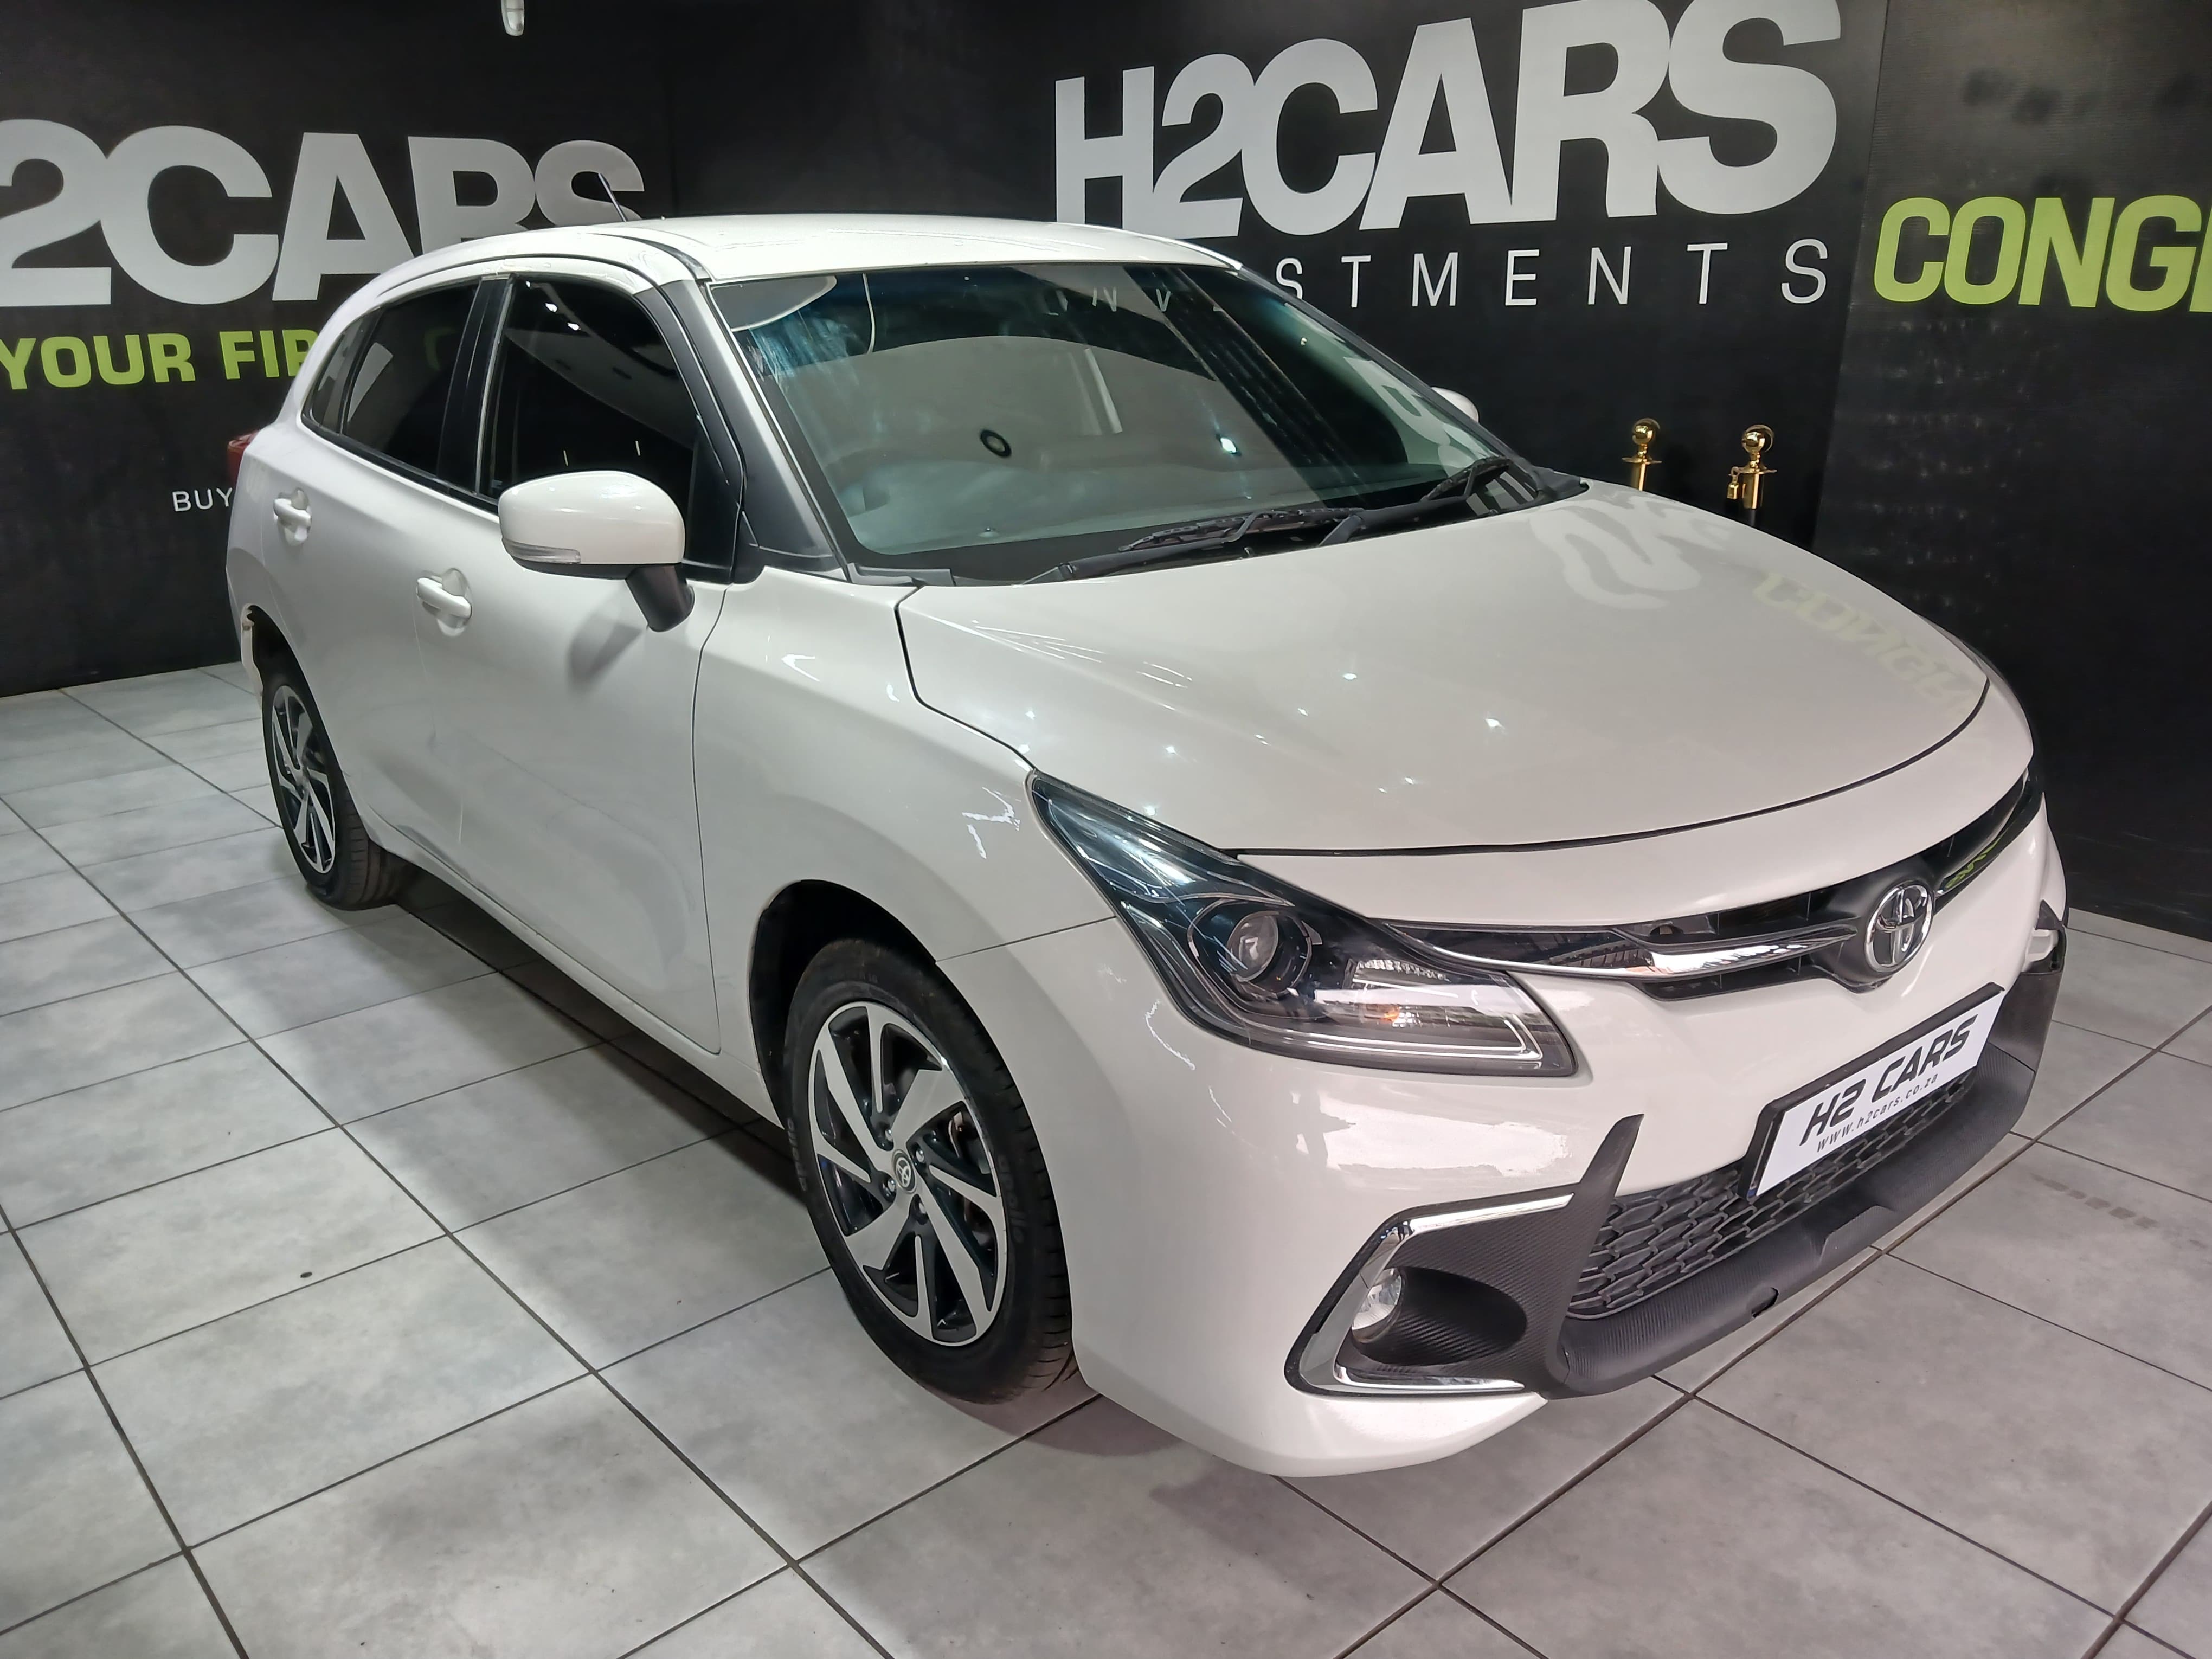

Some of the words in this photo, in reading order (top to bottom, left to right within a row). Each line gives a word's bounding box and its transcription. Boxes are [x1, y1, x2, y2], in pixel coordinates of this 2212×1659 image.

[1056, 0, 1842, 240] H2CARS
[0, 333, 196, 390] YOUR
[172, 487, 233, 512] BUY
[1799, 1079, 1866, 1146] H2
[1872, 1014, 1978, 1103] CARS
